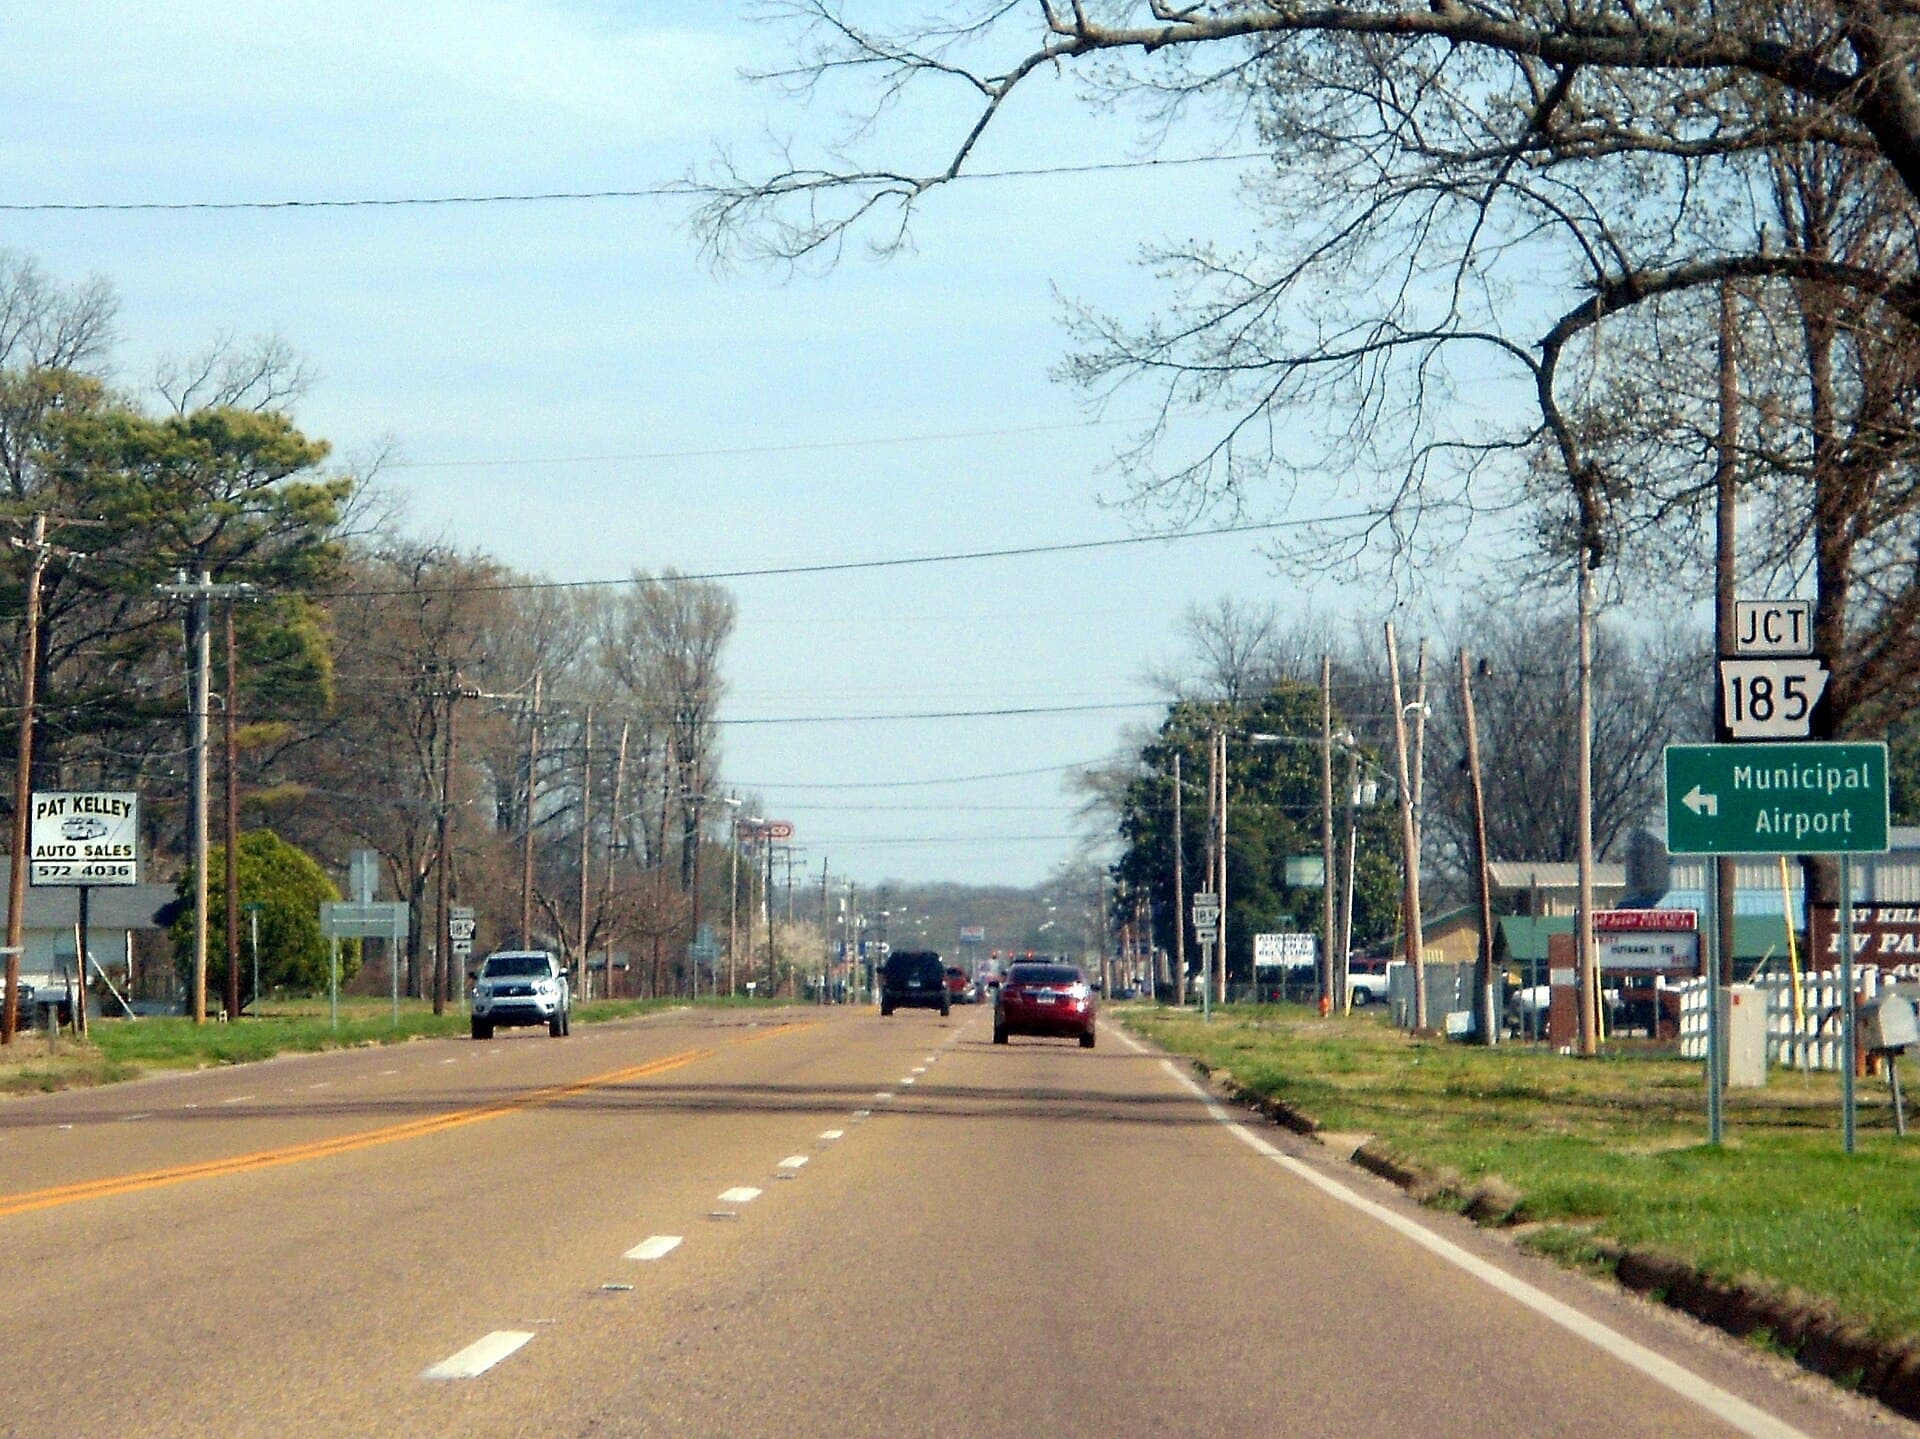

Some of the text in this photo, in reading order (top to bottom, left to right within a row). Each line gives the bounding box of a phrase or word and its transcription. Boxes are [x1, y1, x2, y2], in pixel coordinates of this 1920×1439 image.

[1740, 609, 1804, 644] JCT
[1731, 675, 1808, 721] 185
[1733, 762, 1871, 795] Municipal
[37, 797, 131, 819] PAT KELLEY
[1756, 807, 1852, 839] Airport
[36, 844, 132, 857] AUTO SALES
[38, 865, 129, 876] 572 4036
[1876, 908, 1920, 922] KEL
[452, 923, 471, 935] 185
[1878, 933, 1920, 952] PA
